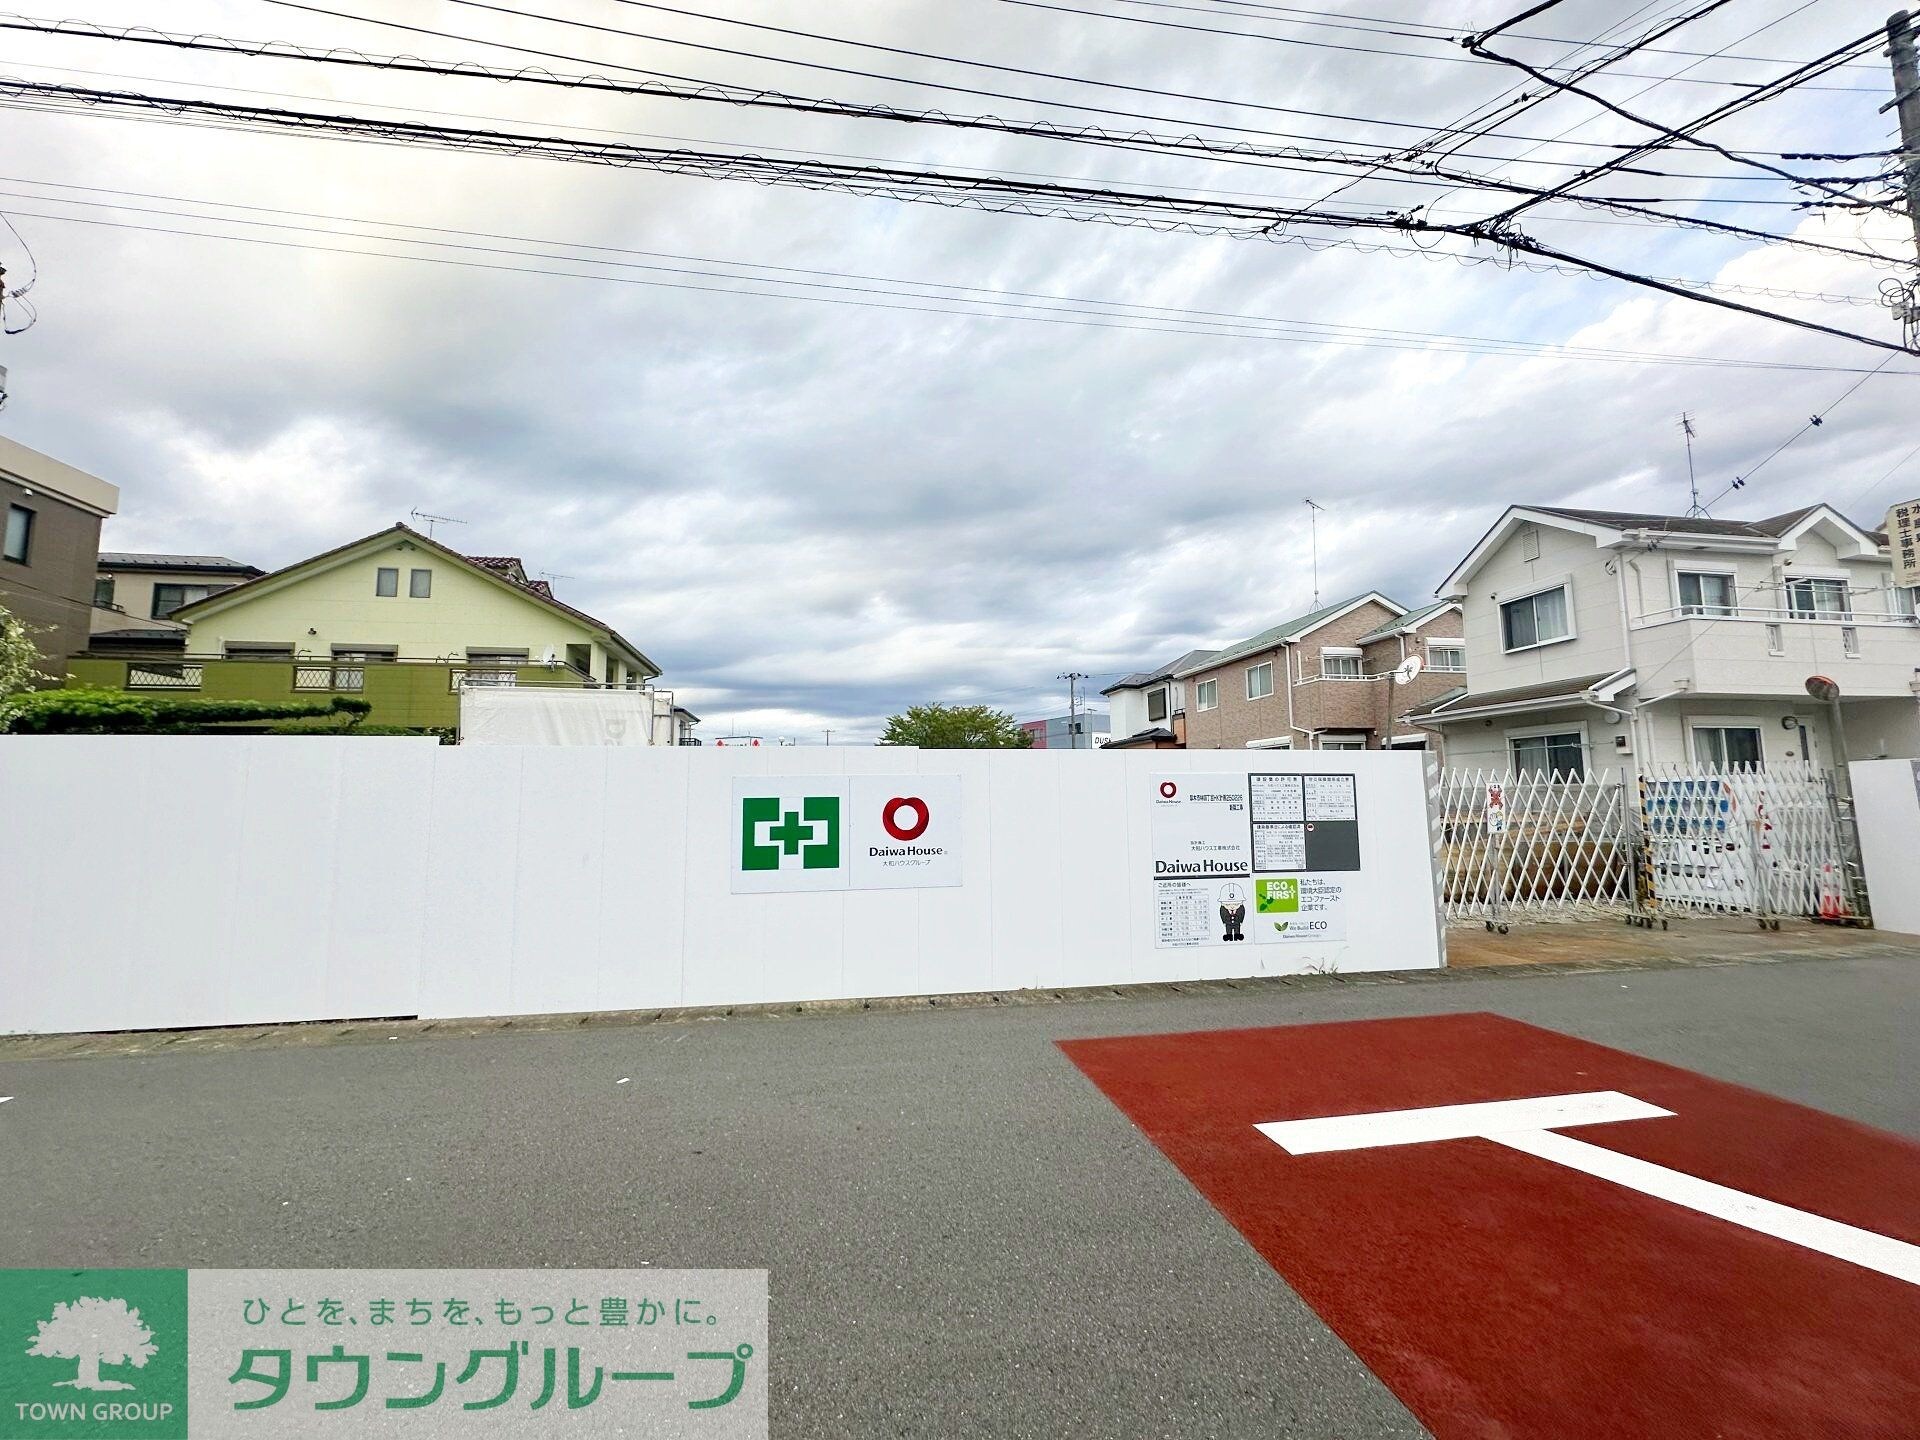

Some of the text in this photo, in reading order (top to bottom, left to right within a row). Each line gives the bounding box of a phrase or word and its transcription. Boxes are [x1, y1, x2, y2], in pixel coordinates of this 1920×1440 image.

[1896, 507, 1916, 569] 税理士事務所
[869, 846, 943, 857] Daiwa House
[1155, 859, 1248, 873] Daiwa House
[1266, 881, 1288, 891] ECO
[1301, 904, 1328, 912] 企業です。
[1309, 921, 1328, 930] ECO
